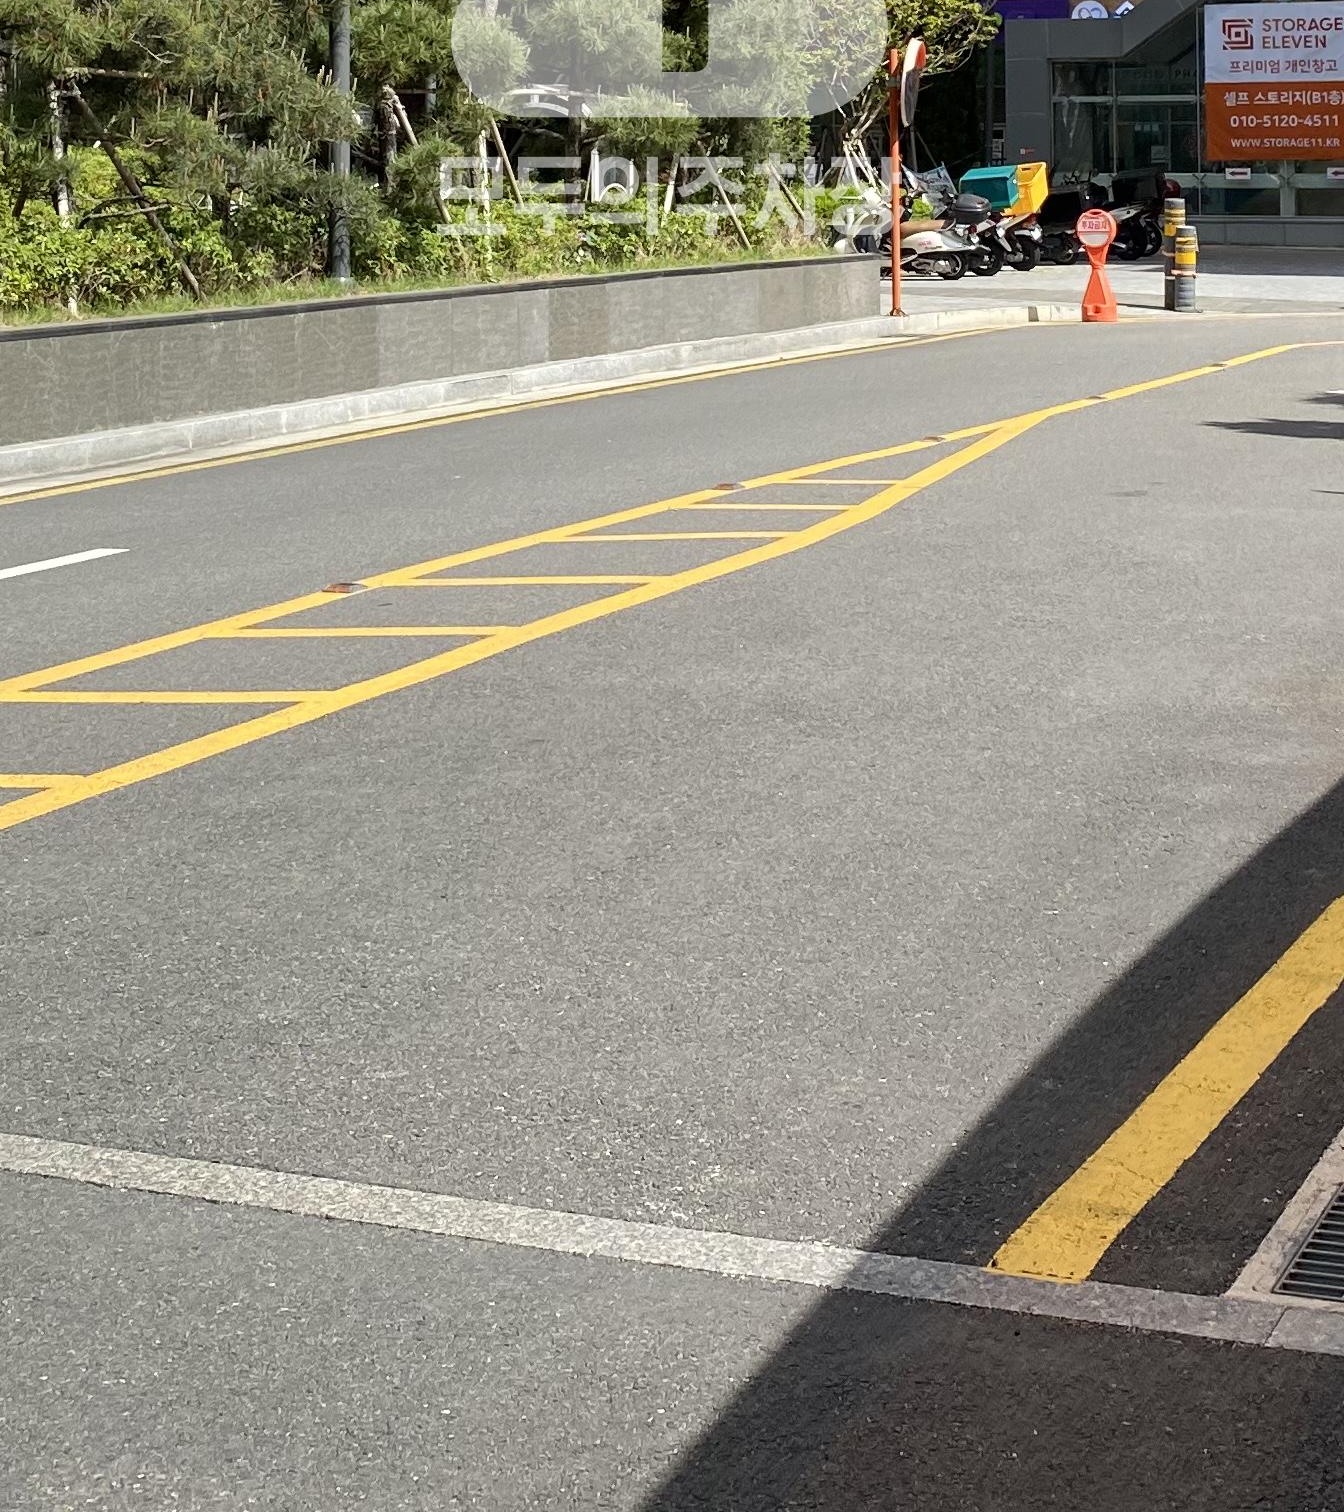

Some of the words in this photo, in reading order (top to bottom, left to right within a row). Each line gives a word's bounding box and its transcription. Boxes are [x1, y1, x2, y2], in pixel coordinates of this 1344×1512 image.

[1262, 17, 1344, 32] STORAGE
[1262, 35, 1327, 49] ELEVEN
[1229, 60, 1281, 75] 프리미엄
[1285, 59, 1338, 74] 개인창고
[1224, 92, 1250, 106] 셀프
[1230, 115, 1339, 128] 010-5120-4511
[1231, 138, 1341, 148] WWW.STORAGE11.KR
